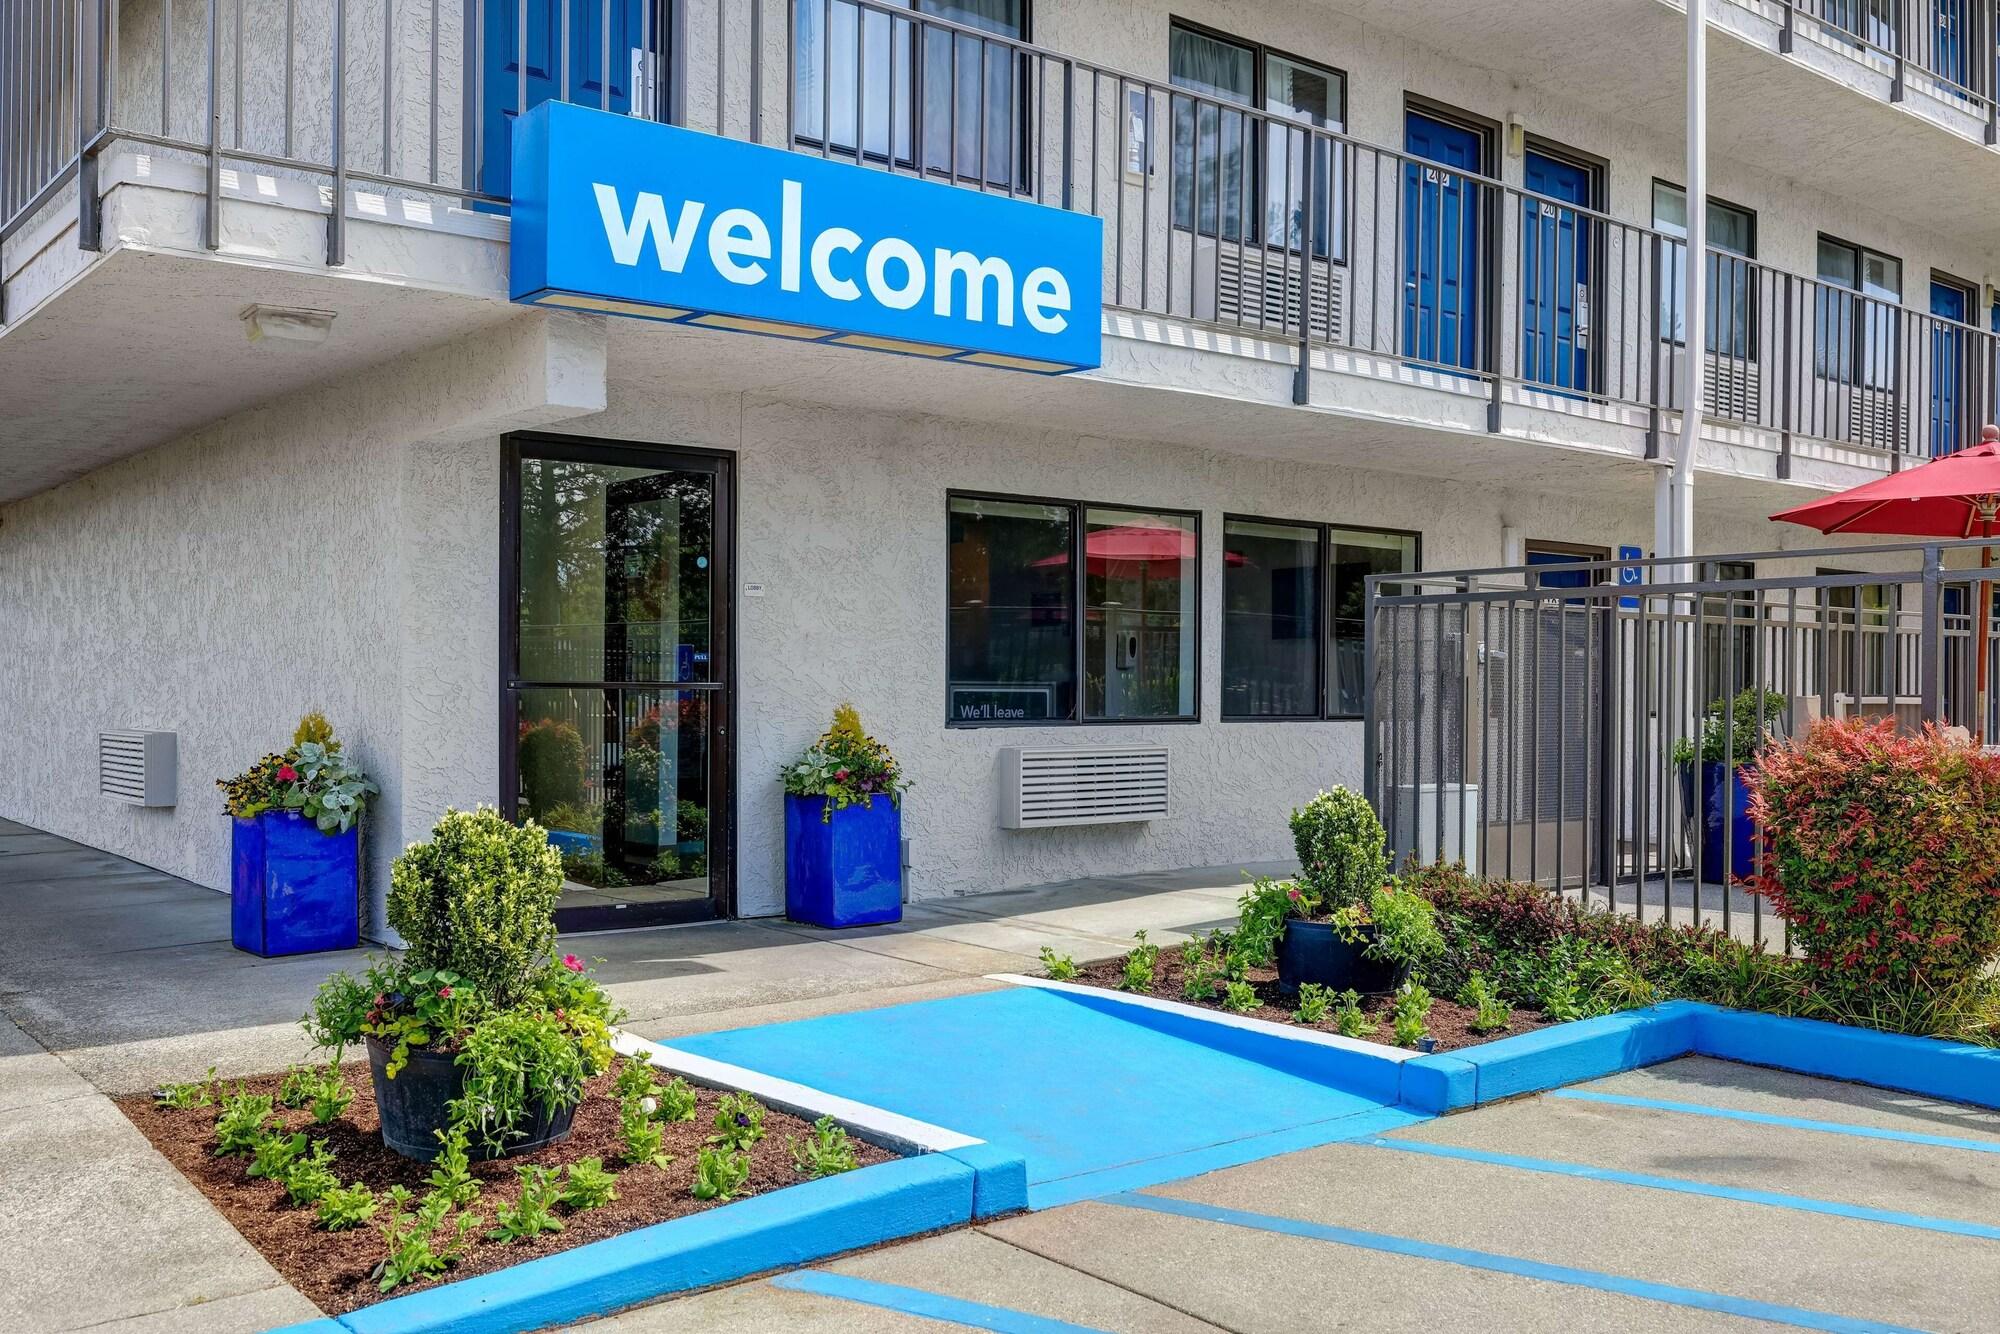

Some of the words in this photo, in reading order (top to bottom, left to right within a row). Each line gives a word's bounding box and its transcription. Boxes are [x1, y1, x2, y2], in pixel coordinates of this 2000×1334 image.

[592, 179, 1071, 334] welcome
[960, 704, 990, 718] We'll
[994, 704, 1025, 718] leave
